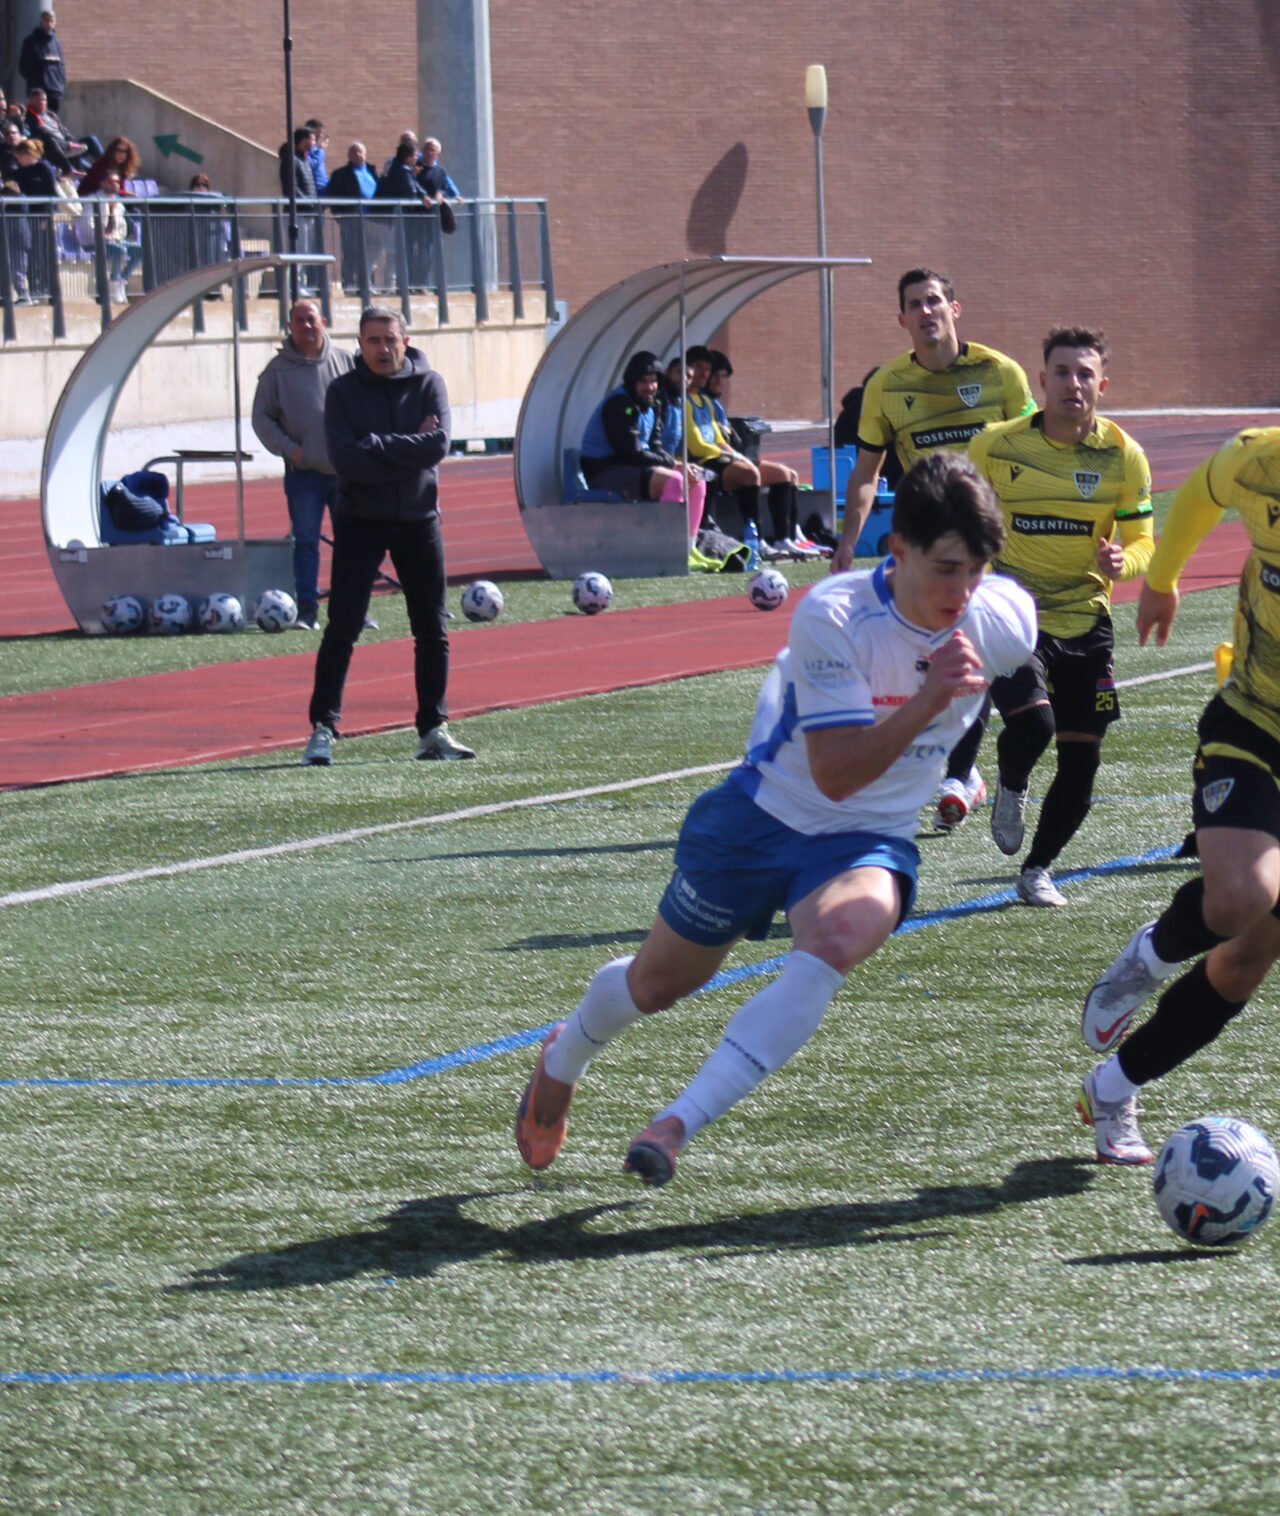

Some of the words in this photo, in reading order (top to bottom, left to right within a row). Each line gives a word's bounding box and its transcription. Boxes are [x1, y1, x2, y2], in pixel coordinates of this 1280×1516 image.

[915, 427, 981, 445] COSENTINO
[1015, 517, 1089, 532] COSENTINO
[1096, 691, 1114, 711] 25
